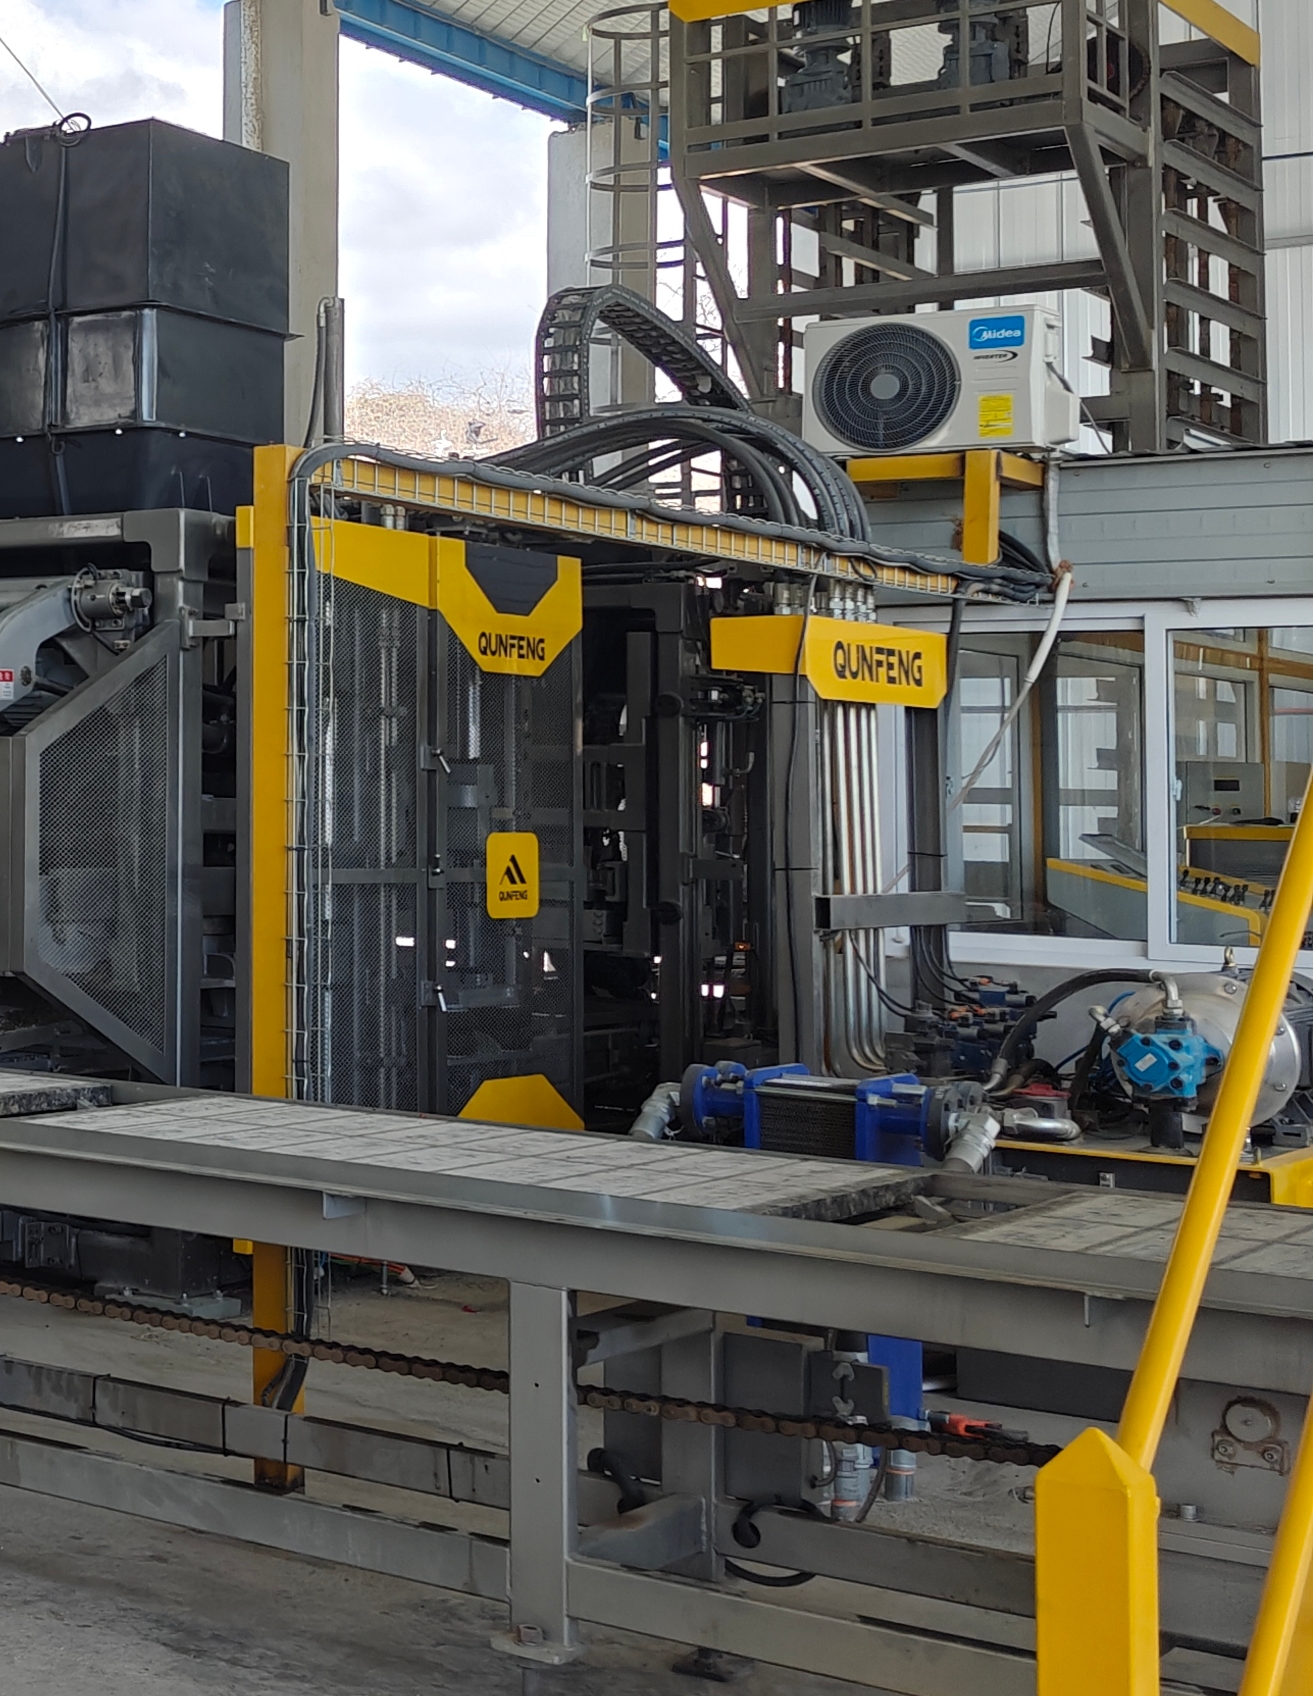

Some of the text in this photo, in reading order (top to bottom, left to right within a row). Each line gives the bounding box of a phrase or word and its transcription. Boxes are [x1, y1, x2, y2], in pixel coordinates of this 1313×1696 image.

[978, 327, 1021, 341] Midea
[478, 631, 545, 661] QUNFENG
[833, 640, 923, 687] QUNFENG
[499, 890, 528, 901] QUNFENG
